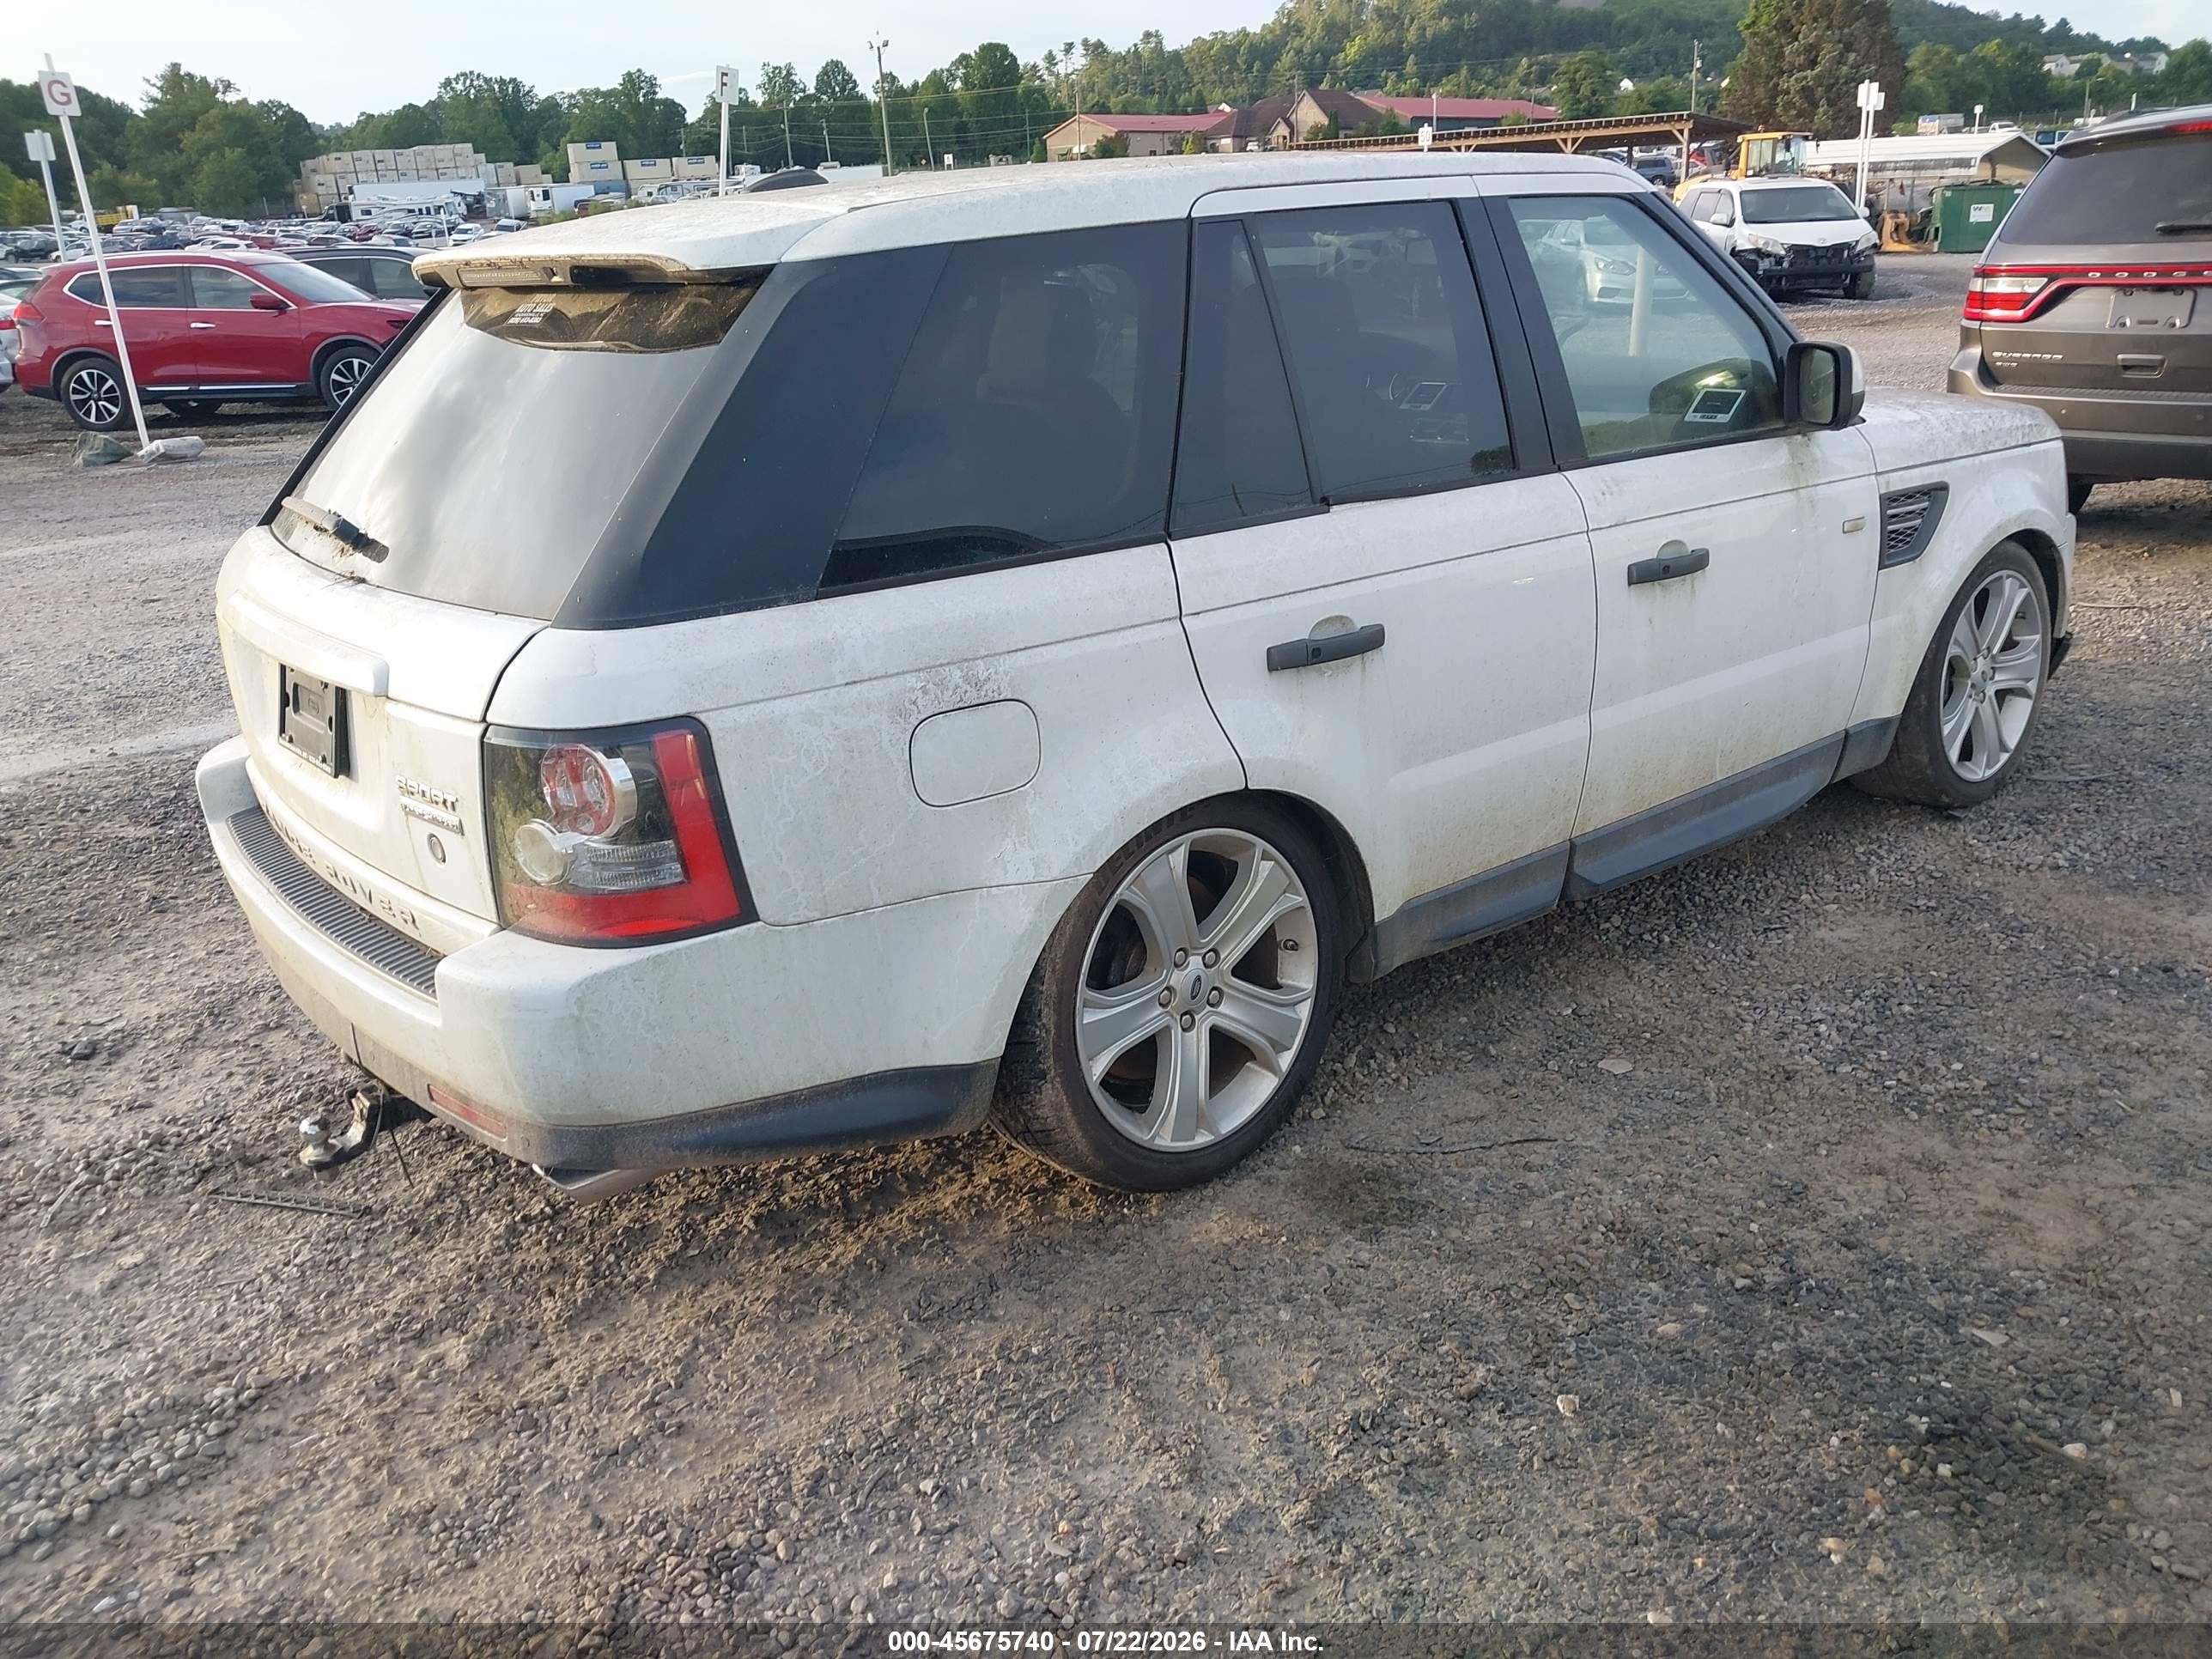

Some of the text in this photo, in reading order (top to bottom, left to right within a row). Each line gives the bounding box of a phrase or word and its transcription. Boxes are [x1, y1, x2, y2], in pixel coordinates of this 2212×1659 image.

[47, 79, 72, 106] G
[720, 71, 729, 97] F
[1992, 351, 2063, 360] DURANGO
[395, 774, 459, 812] SPORT
